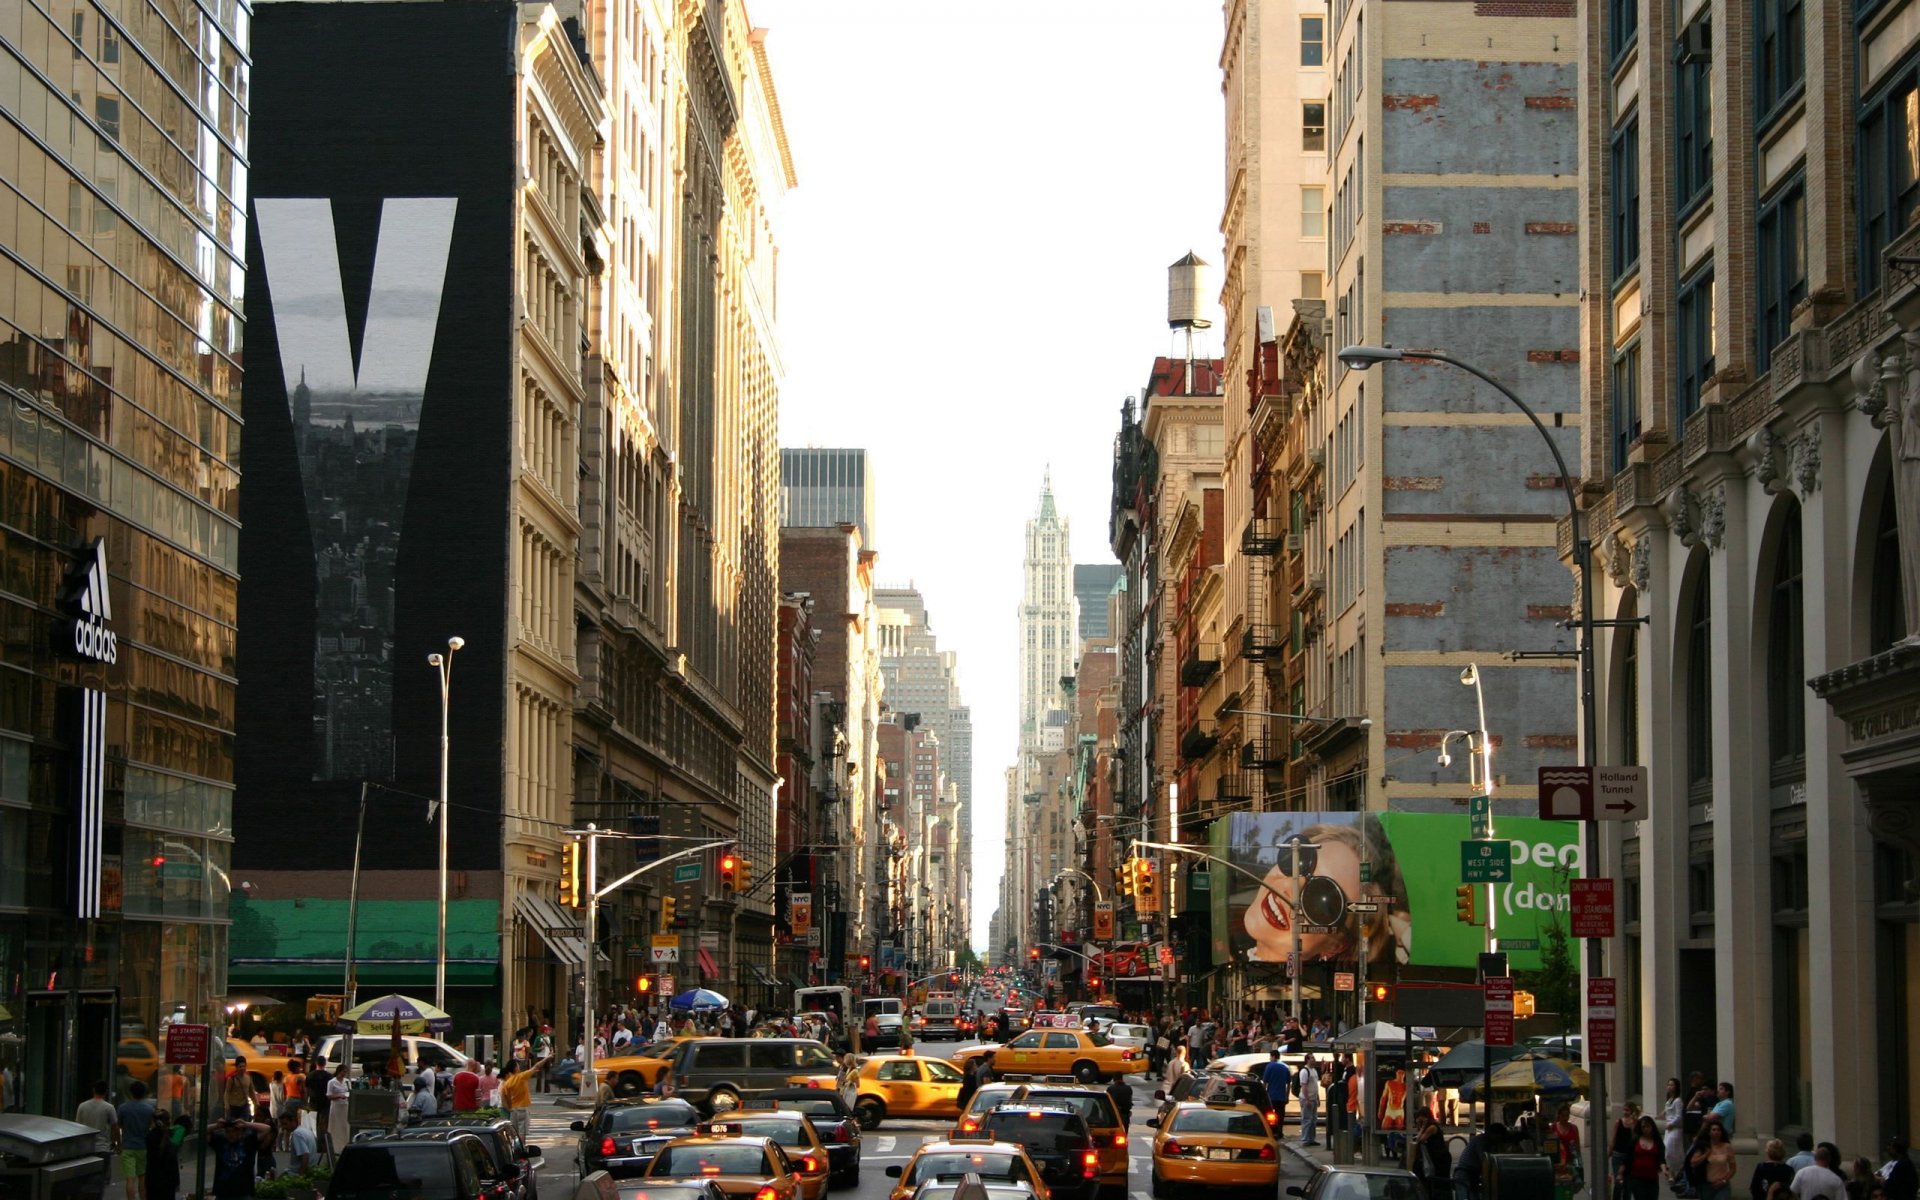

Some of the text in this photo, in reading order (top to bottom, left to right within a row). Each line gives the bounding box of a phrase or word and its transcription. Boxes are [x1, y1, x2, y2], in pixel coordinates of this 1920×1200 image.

[76, 613, 117, 665] adidas
[1600, 772, 1639, 782] Holland
[1601, 785, 1633, 794] Tunnel
[1572, 882, 1612, 892] SNOW ROUTE
[1572, 905, 1612, 913] NO STANDING
[371, 1010, 413, 1018] Foxtns
[370, 1023, 385, 1031] Sell
